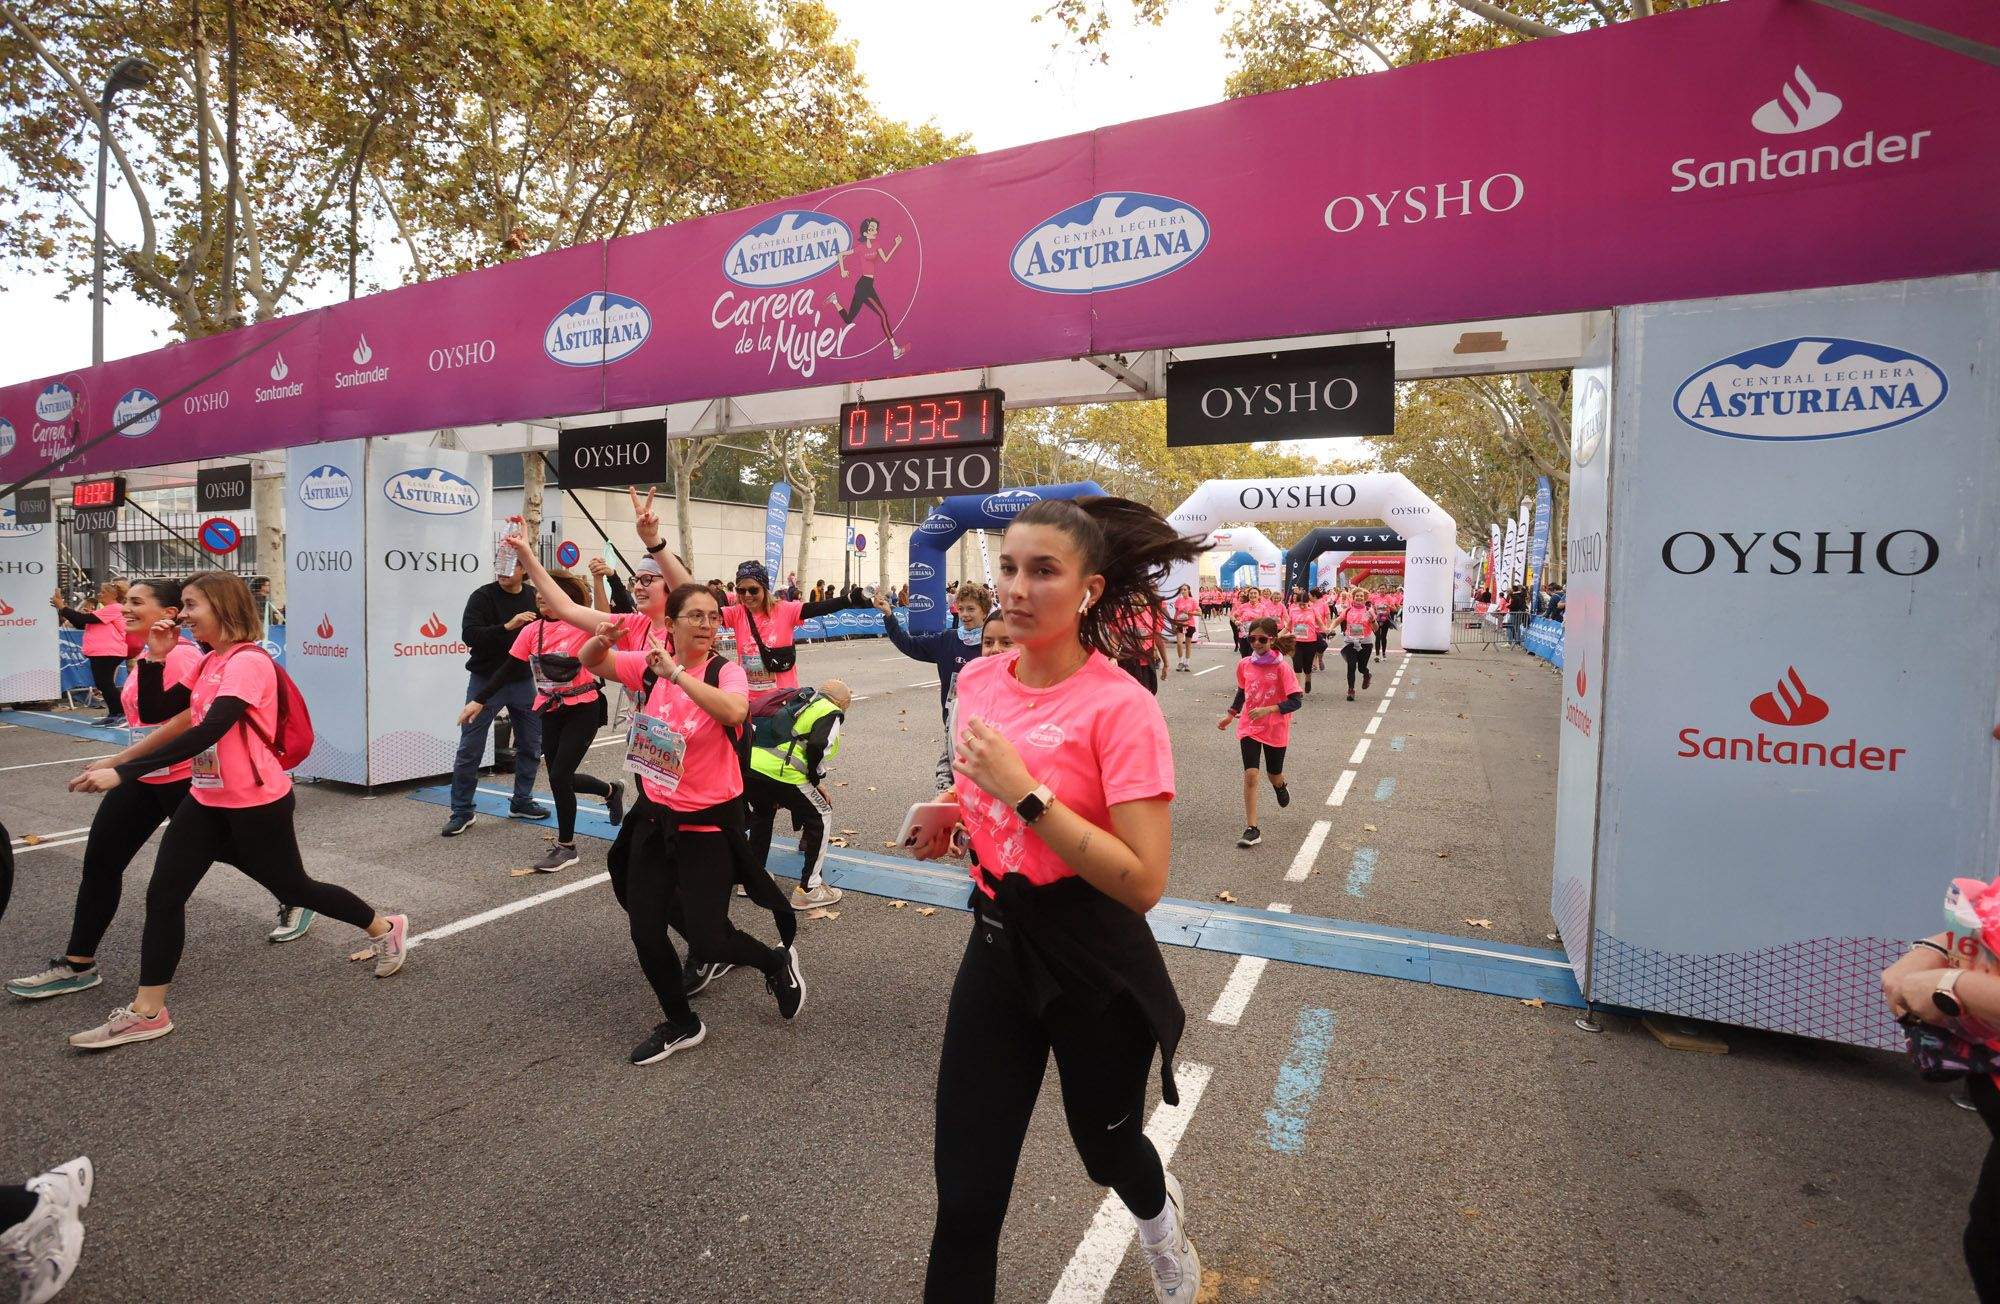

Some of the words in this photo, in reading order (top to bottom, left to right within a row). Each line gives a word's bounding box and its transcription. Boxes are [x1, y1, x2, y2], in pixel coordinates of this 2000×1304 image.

[1671, 131, 1932, 193] Santander
[1324, 173, 1525, 233] OYSHO
[751, 237, 792, 251] CENTRAL
[795, 227, 838, 242] LECHERA
[1053, 227, 1114, 245] CENTRAL
[1120, 215, 1186, 233] LECHERA
[732, 237, 842, 276] ASTURIANA
[1024, 229, 1193, 277] ASTURIANA
[604, 312, 640, 323] ECHERA
[711, 289, 815, 330] Carrera
[552, 321, 643, 352] ASTURIANA
[735, 327, 754, 355] de
[758, 325, 772, 352] la
[768, 314, 857, 378] Mujer
[429, 339, 496, 372] OYSHO
[335, 366, 390, 388] Santander
[1732, 374, 1815, 387] CENTRAL
[1824, 368, 1915, 382] LECHERA
[184, 390, 229, 415] OYSHO
[255, 381, 304, 403] Santander
[1201, 377, 1358, 419] OYSHO
[1692, 381, 1923, 418] ASTURIANA
[849, 400, 987, 446] 01:33:21
[575, 442, 650, 469] OYSHO
[846, 453, 991, 495] OYSHO
[205, 481, 244, 500] OYSHO
[303, 485, 349, 500] ASTURIANA
[391, 481, 474, 507] ASTURIANA
[1239, 483, 1357, 509] OYSHO
[20, 499, 47, 514] OYSHO
[1174, 513, 1207, 521] OYSHO
[1391, 506, 1430, 516] OYSHO
[75, 510, 116, 531] OYSHO
[297, 550, 352, 572] OYSHO
[384, 550, 479, 573] OYSHO
[1411, 556, 1447, 565] OYSHO
[1570, 532, 1601, 574] OYSHO
[1662, 529, 1940, 576] OYSHO
[1408, 605, 1444, 614] OYSHO
[302, 641, 348, 658] Santander
[1677, 728, 1906, 772] Santander
